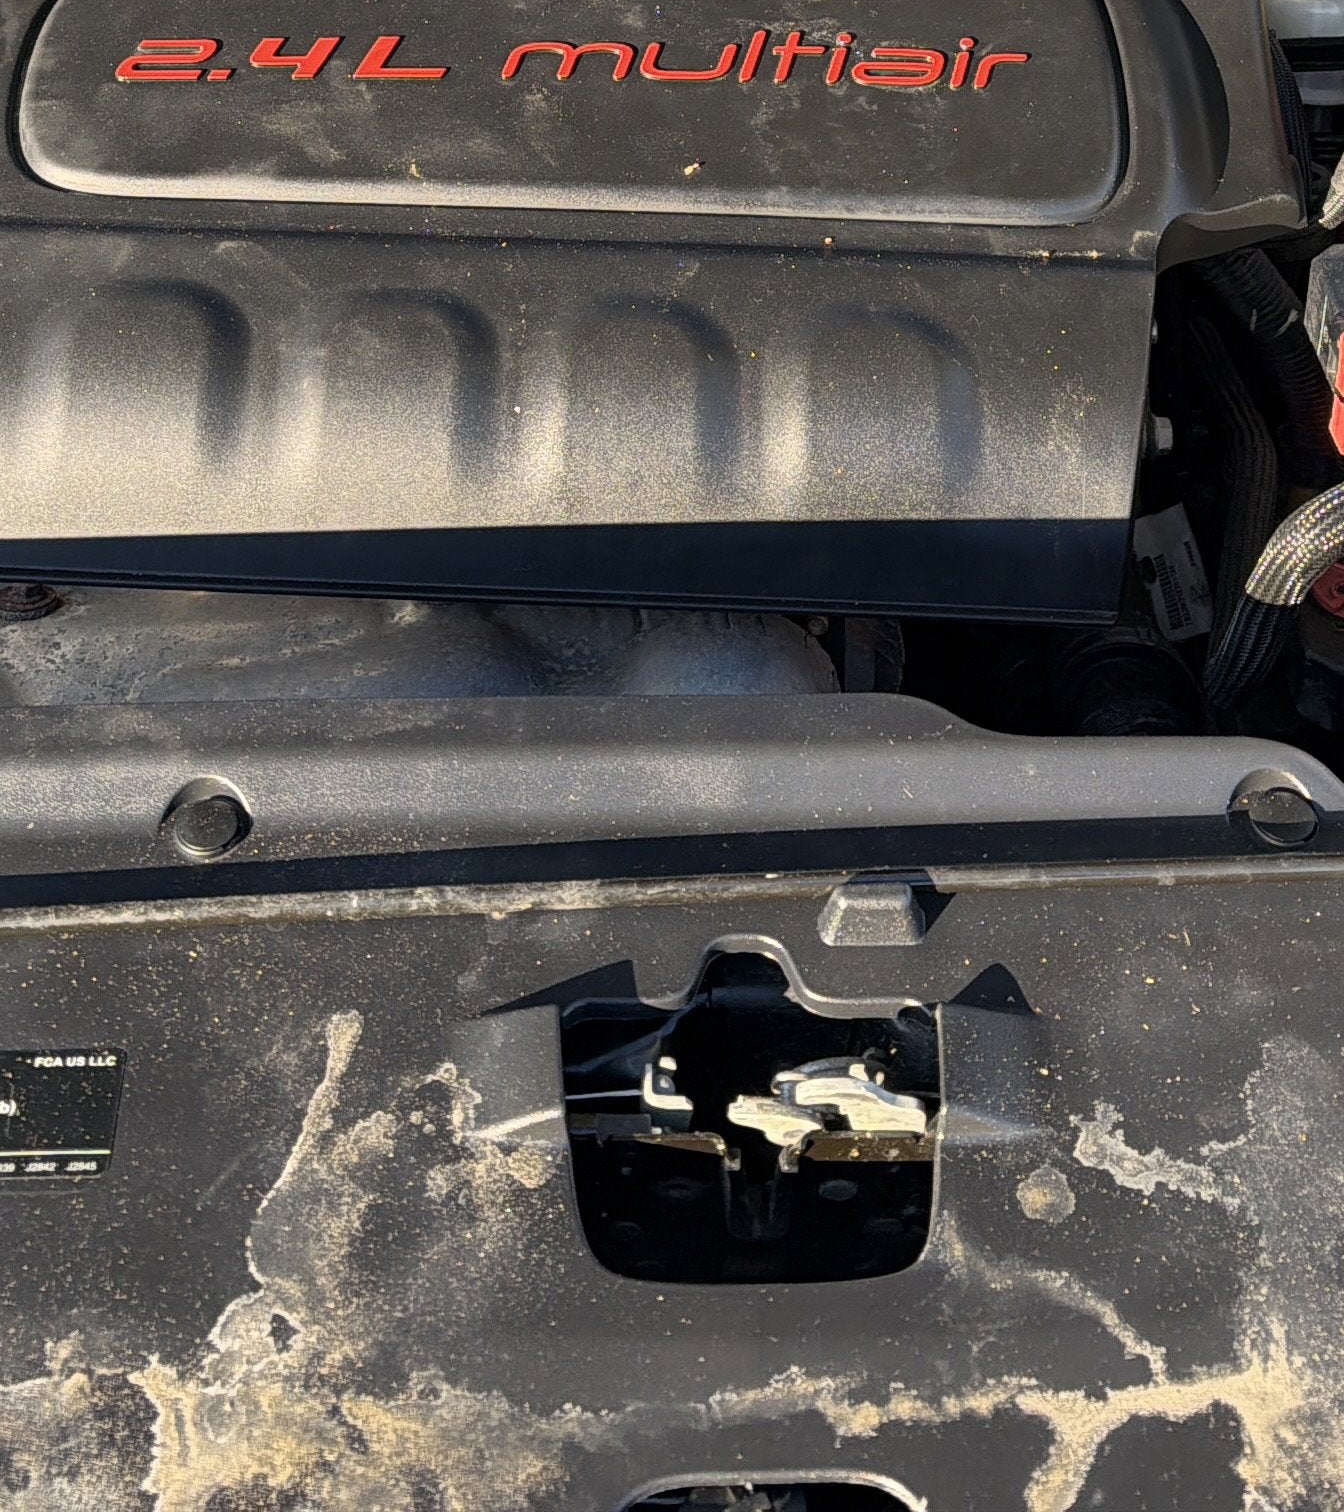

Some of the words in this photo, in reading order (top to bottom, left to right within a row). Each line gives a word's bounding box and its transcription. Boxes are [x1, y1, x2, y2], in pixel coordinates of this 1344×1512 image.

[501, 29, 1033, 90] multiair
[34, 1056, 64, 1068] FCA
[66, 1056, 86, 1067] US
[88, 1055, 117, 1067] LLC
